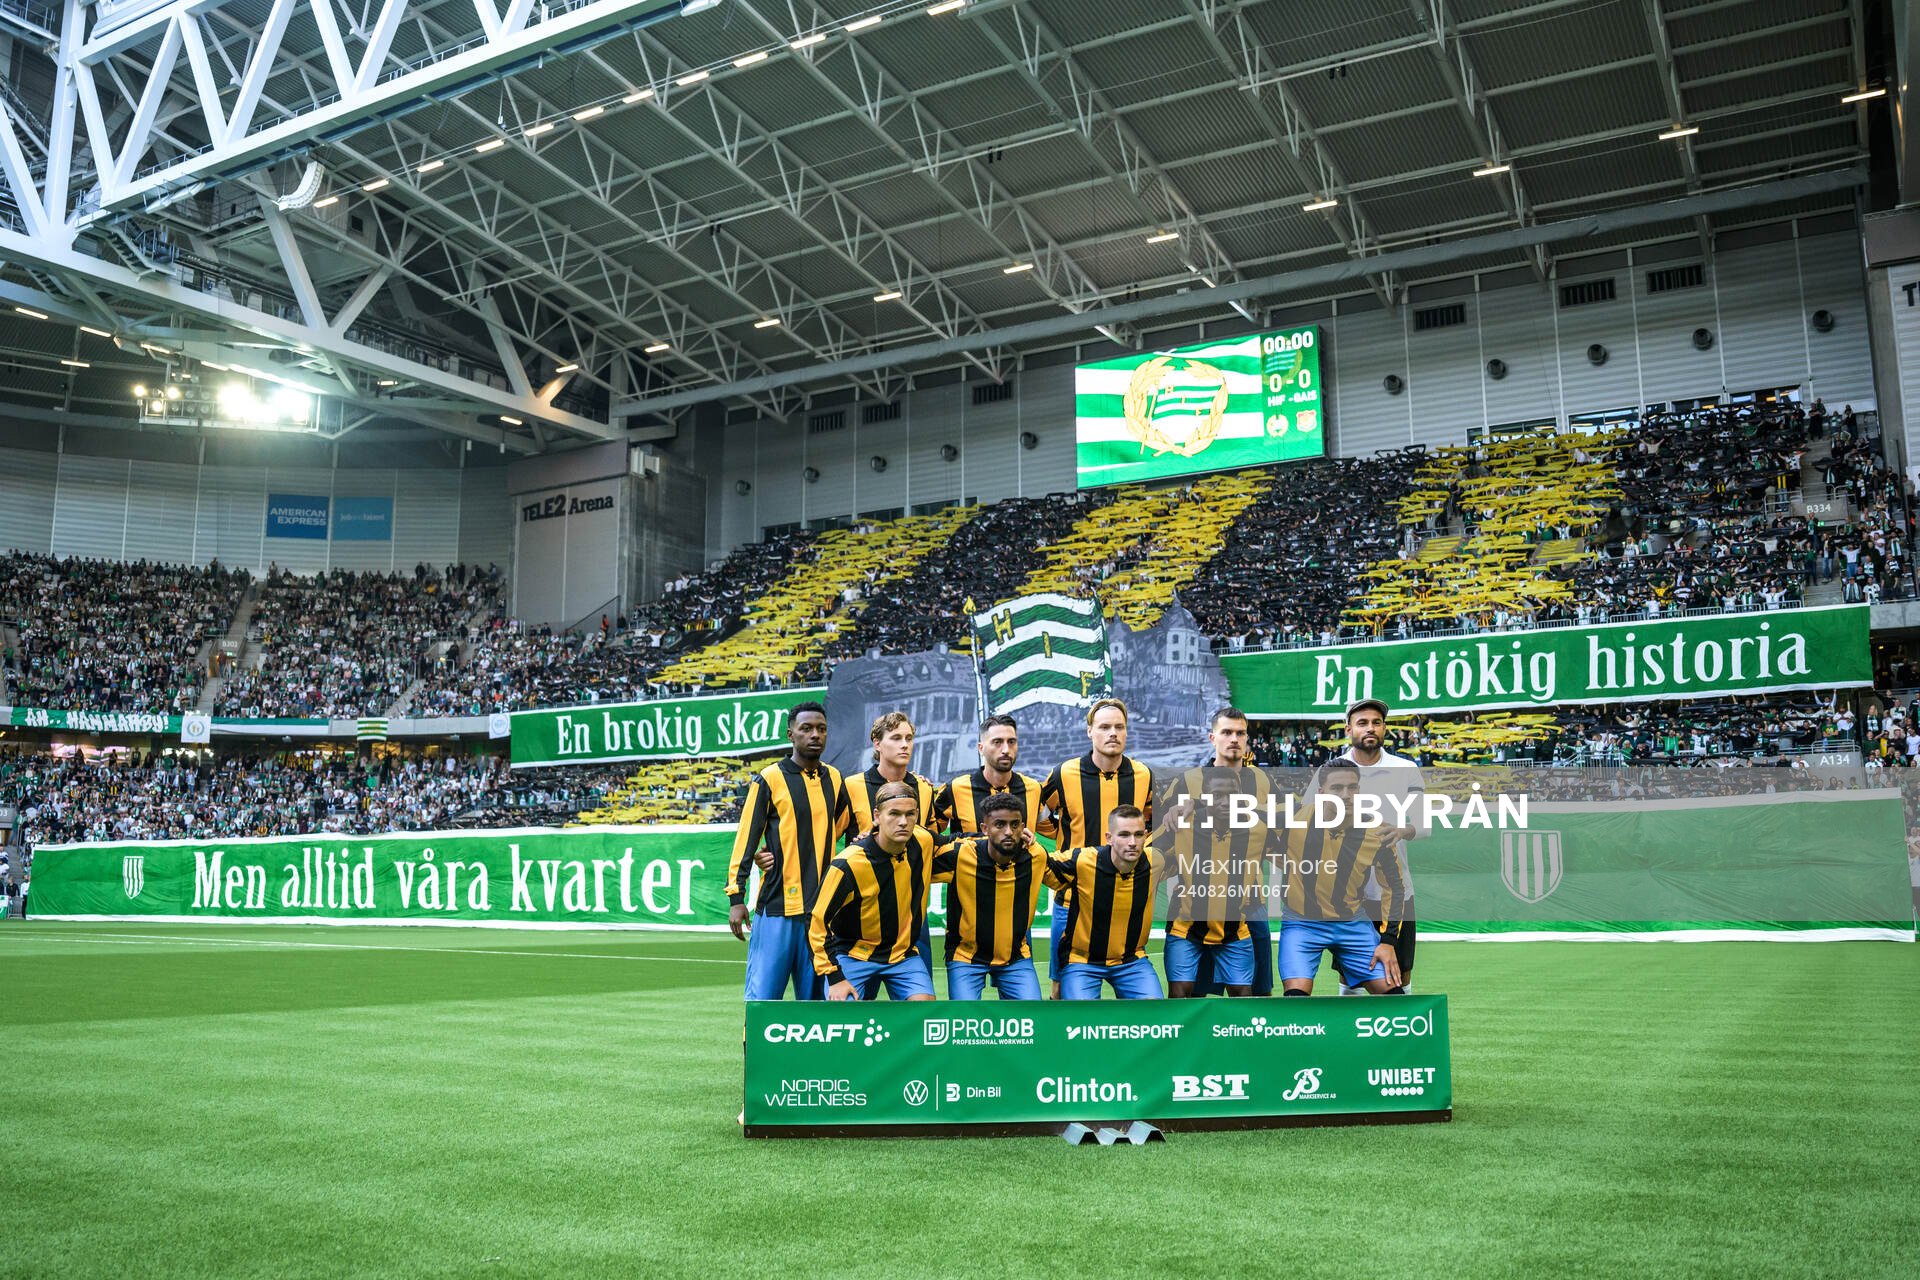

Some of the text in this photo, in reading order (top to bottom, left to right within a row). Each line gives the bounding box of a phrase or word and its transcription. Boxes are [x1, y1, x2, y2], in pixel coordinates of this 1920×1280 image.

[1263, 331, 1314, 354] 00:00
[1269, 374, 1282, 392] 0
[1298, 369, 1311, 388] 0
[1267, 394, 1286, 407] HIF
[270, 507, 326, 517] AMERICAN
[522, 494, 614, 521] TELE2 Arena
[1806, 503, 1831, 513] B334
[277, 516, 326, 526] EXPRESS
[1311, 621, 1812, 706] En stökig historia
[556, 702, 789, 755] En brokig skar
[1819, 753, 1850, 766] A134
[191, 851, 267, 909] Men
[280, 847, 377, 909] alltid
[394, 848, 492, 911] våra
[508, 844, 705, 915] kvarter
[952, 1018, 1034, 1038] PROJOB
[1082, 1024, 1180, 1040] INTERSPORT
[1212, 1023, 1326, 1038] Sefina pantbank
[1355, 1008, 1433, 1038] sesol
[764, 1023, 863, 1043] CRAFT
[781, 1079, 850, 1092] NORDIC
[1172, 1074, 1250, 1098] BST
[1368, 1067, 1436, 1086] UNIBET
[764, 1093, 867, 1107] WELLNESS
[966, 1086, 1001, 1098] Din Bil
